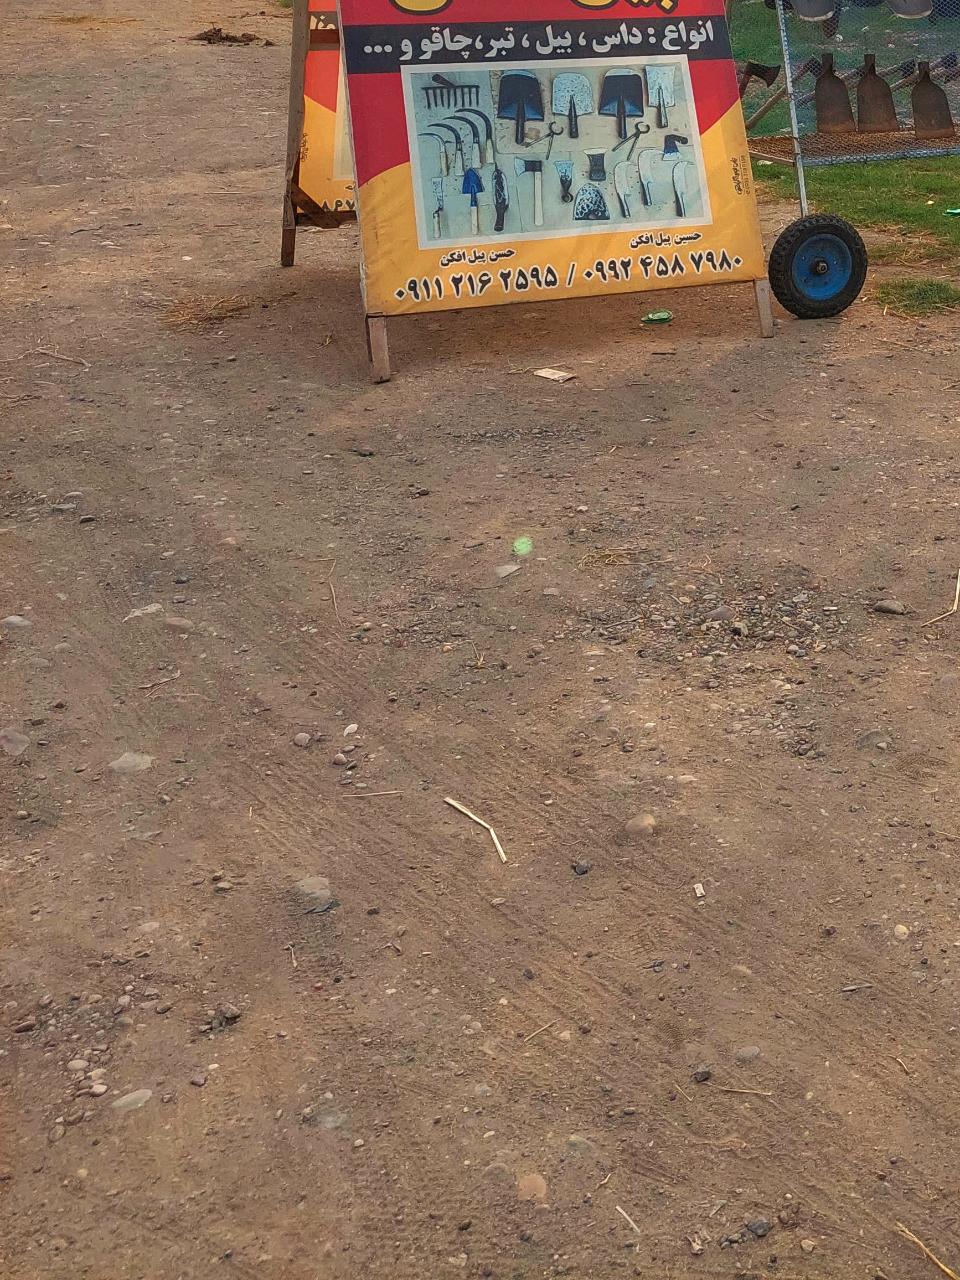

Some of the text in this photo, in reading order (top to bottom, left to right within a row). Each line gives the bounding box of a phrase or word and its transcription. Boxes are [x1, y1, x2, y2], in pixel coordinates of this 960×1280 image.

[399, 38, 413, 61] و
[630, 232, 702, 249] حسین پیل افکن
[440, 248, 515, 266] حسن پیل افکن
[395, 277, 443, 300] ۰۹۱۱
[451, 272, 492, 297] ۲۱۶
[500, 265, 558, 292] ۲۵۹۵
[584, 258, 632, 281] ۰۹۹۲
[639, 254, 685, 278] ۴۵۸
[690, 249, 742, 274] ۷۹۸۰
